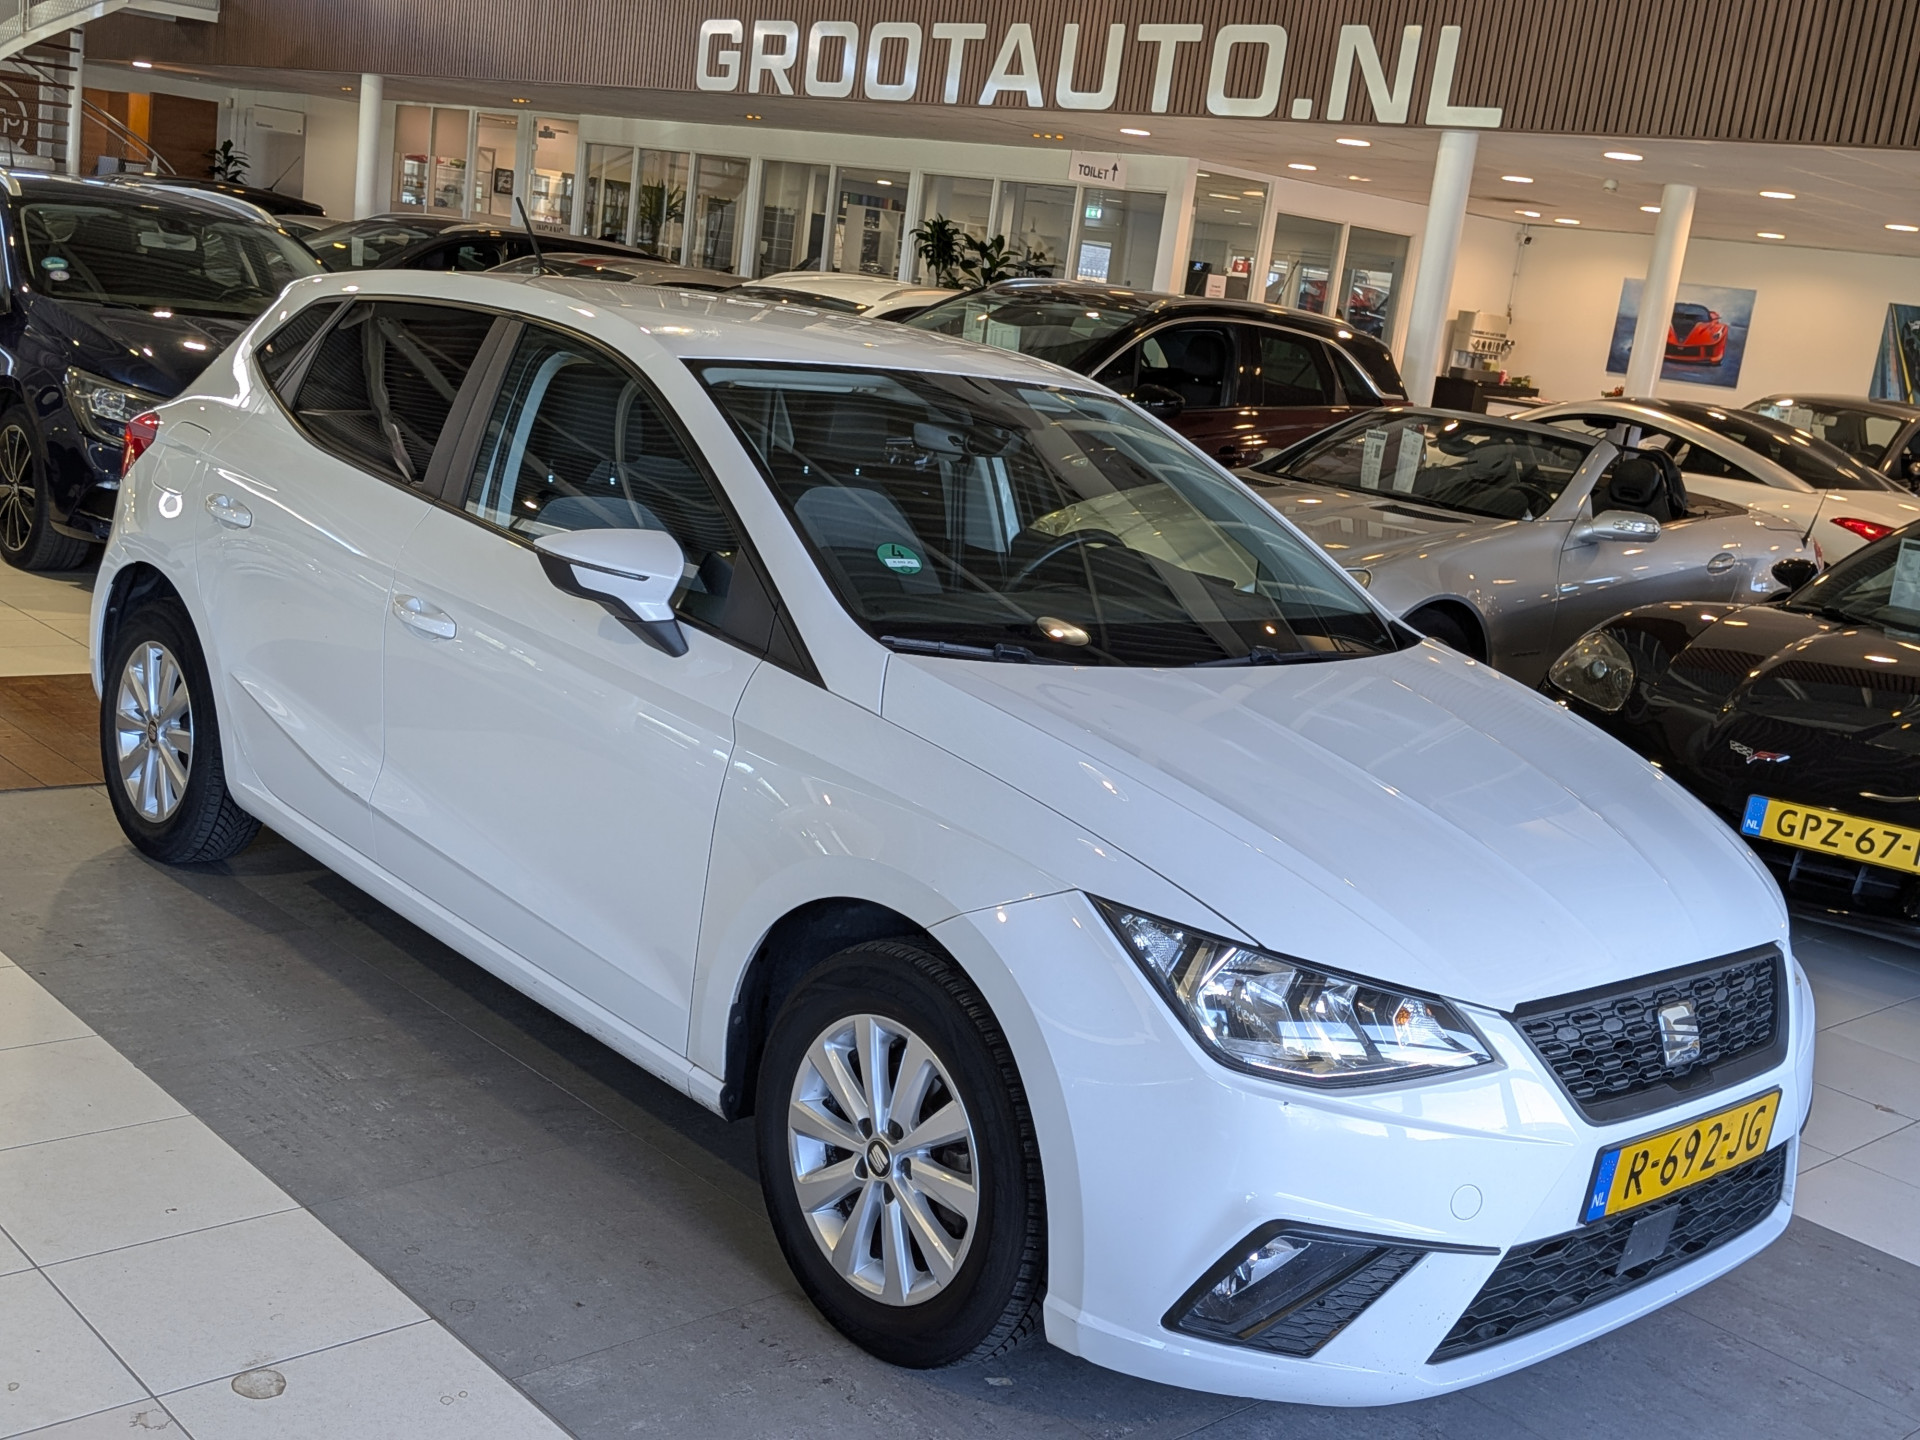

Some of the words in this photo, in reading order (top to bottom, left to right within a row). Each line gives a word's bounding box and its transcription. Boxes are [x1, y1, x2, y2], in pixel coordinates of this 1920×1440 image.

[696, 19, 1503, 128] GROOTAUTO.NL
[1078, 163, 1110, 180] TOILET
[1745, 818, 1760, 830] NL
[1623, 1105, 1767, 1201] R-692-JG
[1590, 1191, 1606, 1209] NL
